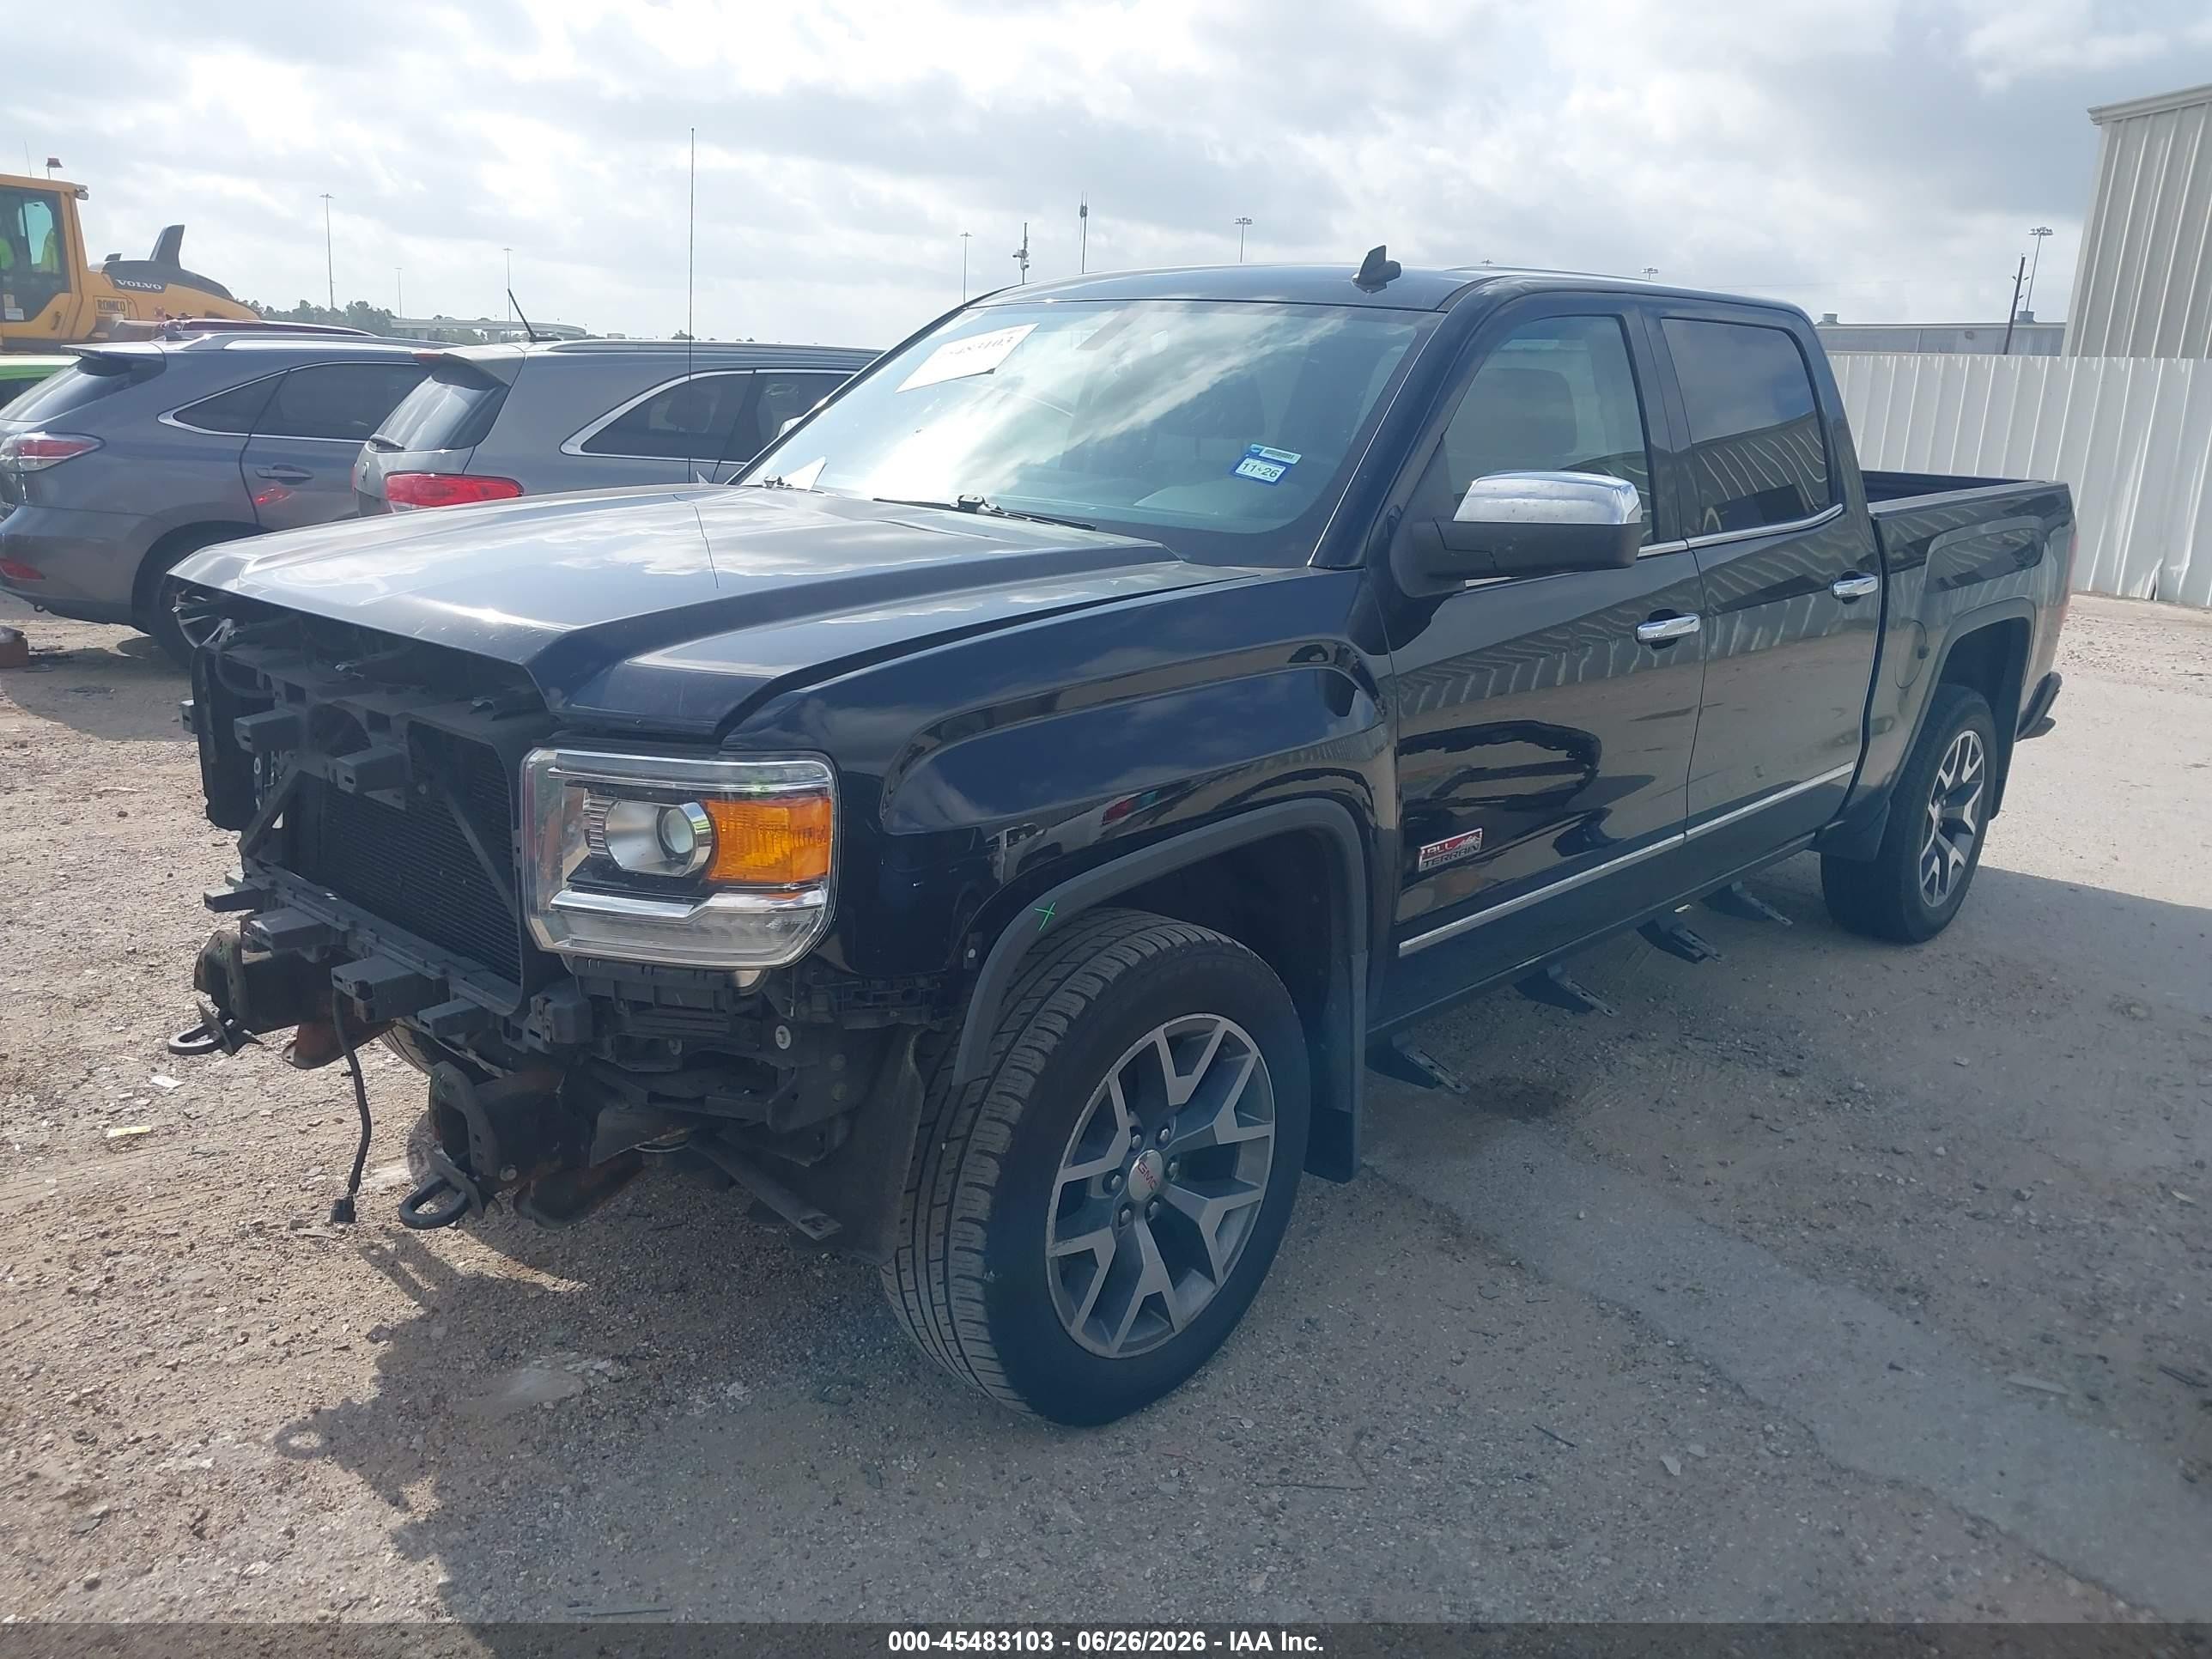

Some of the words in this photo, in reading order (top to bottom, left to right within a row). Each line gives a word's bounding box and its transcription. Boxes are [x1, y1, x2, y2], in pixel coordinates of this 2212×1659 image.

[116, 279, 162, 289] VOLVO
[1261, 467, 1279, 478] 26
[1424, 842, 1480, 867] TERRAIN
[1138, 1161, 1158, 1190] GMC
